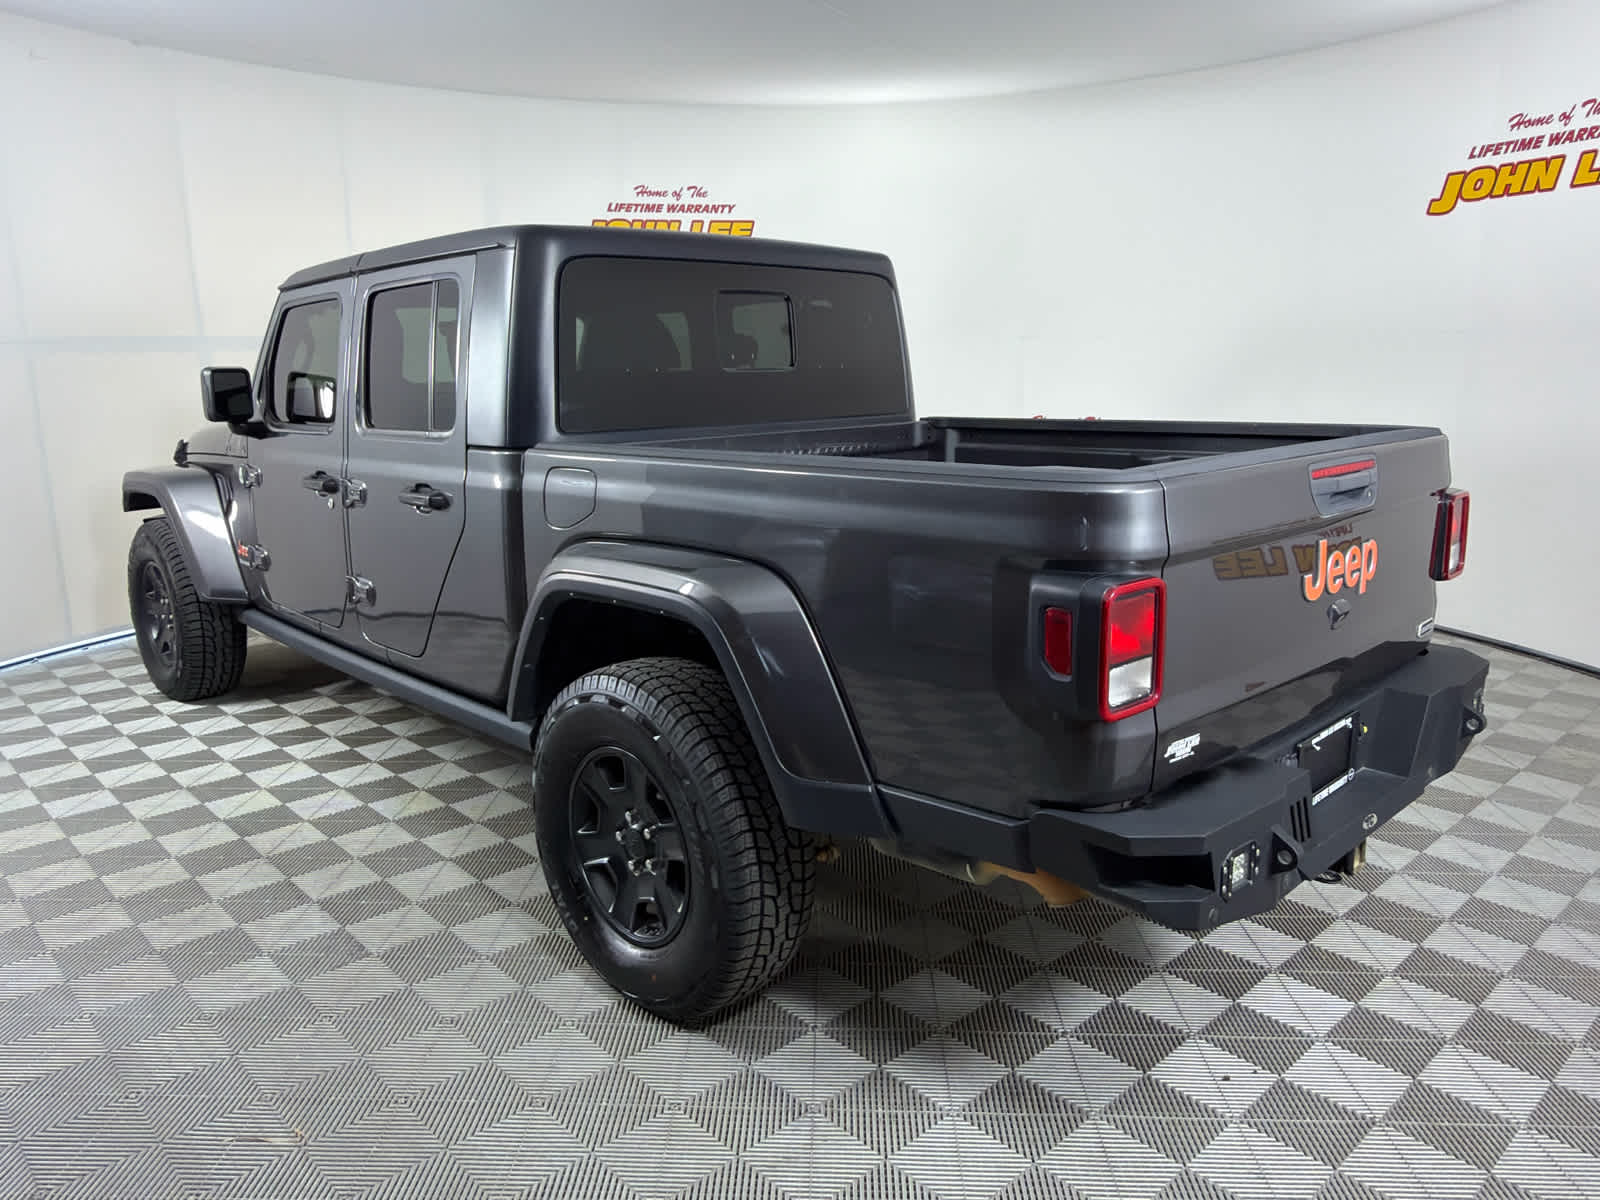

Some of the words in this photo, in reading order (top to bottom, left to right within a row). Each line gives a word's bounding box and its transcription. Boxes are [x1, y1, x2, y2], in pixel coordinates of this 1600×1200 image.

[1508, 113, 1554, 131] Home
[1558, 104, 1577, 126] of
[1468, 135, 1545, 160] LIFETIME
[1547, 125, 1600, 147] WARR
[633, 184, 668, 198] Home
[671, 186, 683, 201] of
[686, 185, 709, 199] The
[1426, 154, 1566, 216] JOHN
[607, 202, 663, 213] LIFETIME
[666, 203, 736, 214] WARRANTY
[1302, 538, 1378, 601] Jeep
